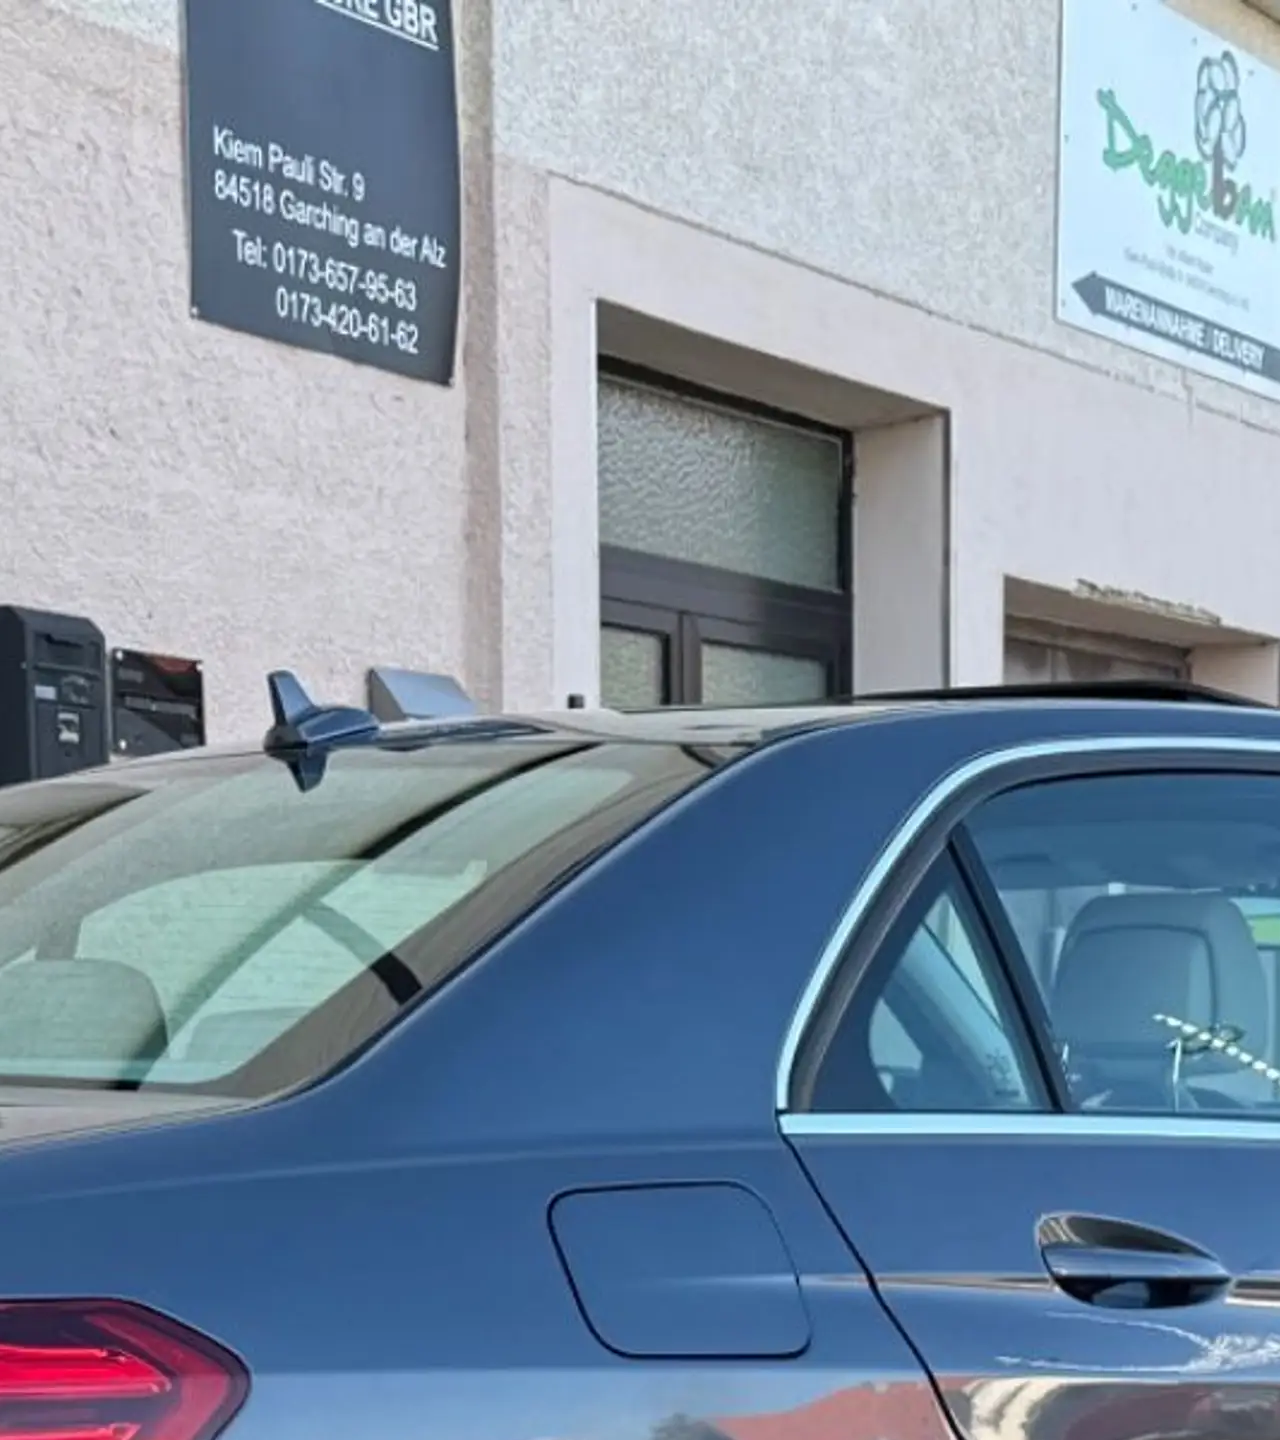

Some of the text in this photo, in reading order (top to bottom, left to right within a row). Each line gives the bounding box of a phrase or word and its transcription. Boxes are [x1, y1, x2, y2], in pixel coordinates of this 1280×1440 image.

[383, 0, 439, 44] GBR
[213, 125, 366, 202] Kiem Pauli Str. 9
[214, 170, 447, 269] 84518 Garching an der Alz
[232, 229, 417, 312] Tel: 0173-657-95-63
[275, 287, 419, 354] 0173-420-61-62
[1213, 327, 1266, 371] DELIVERY
